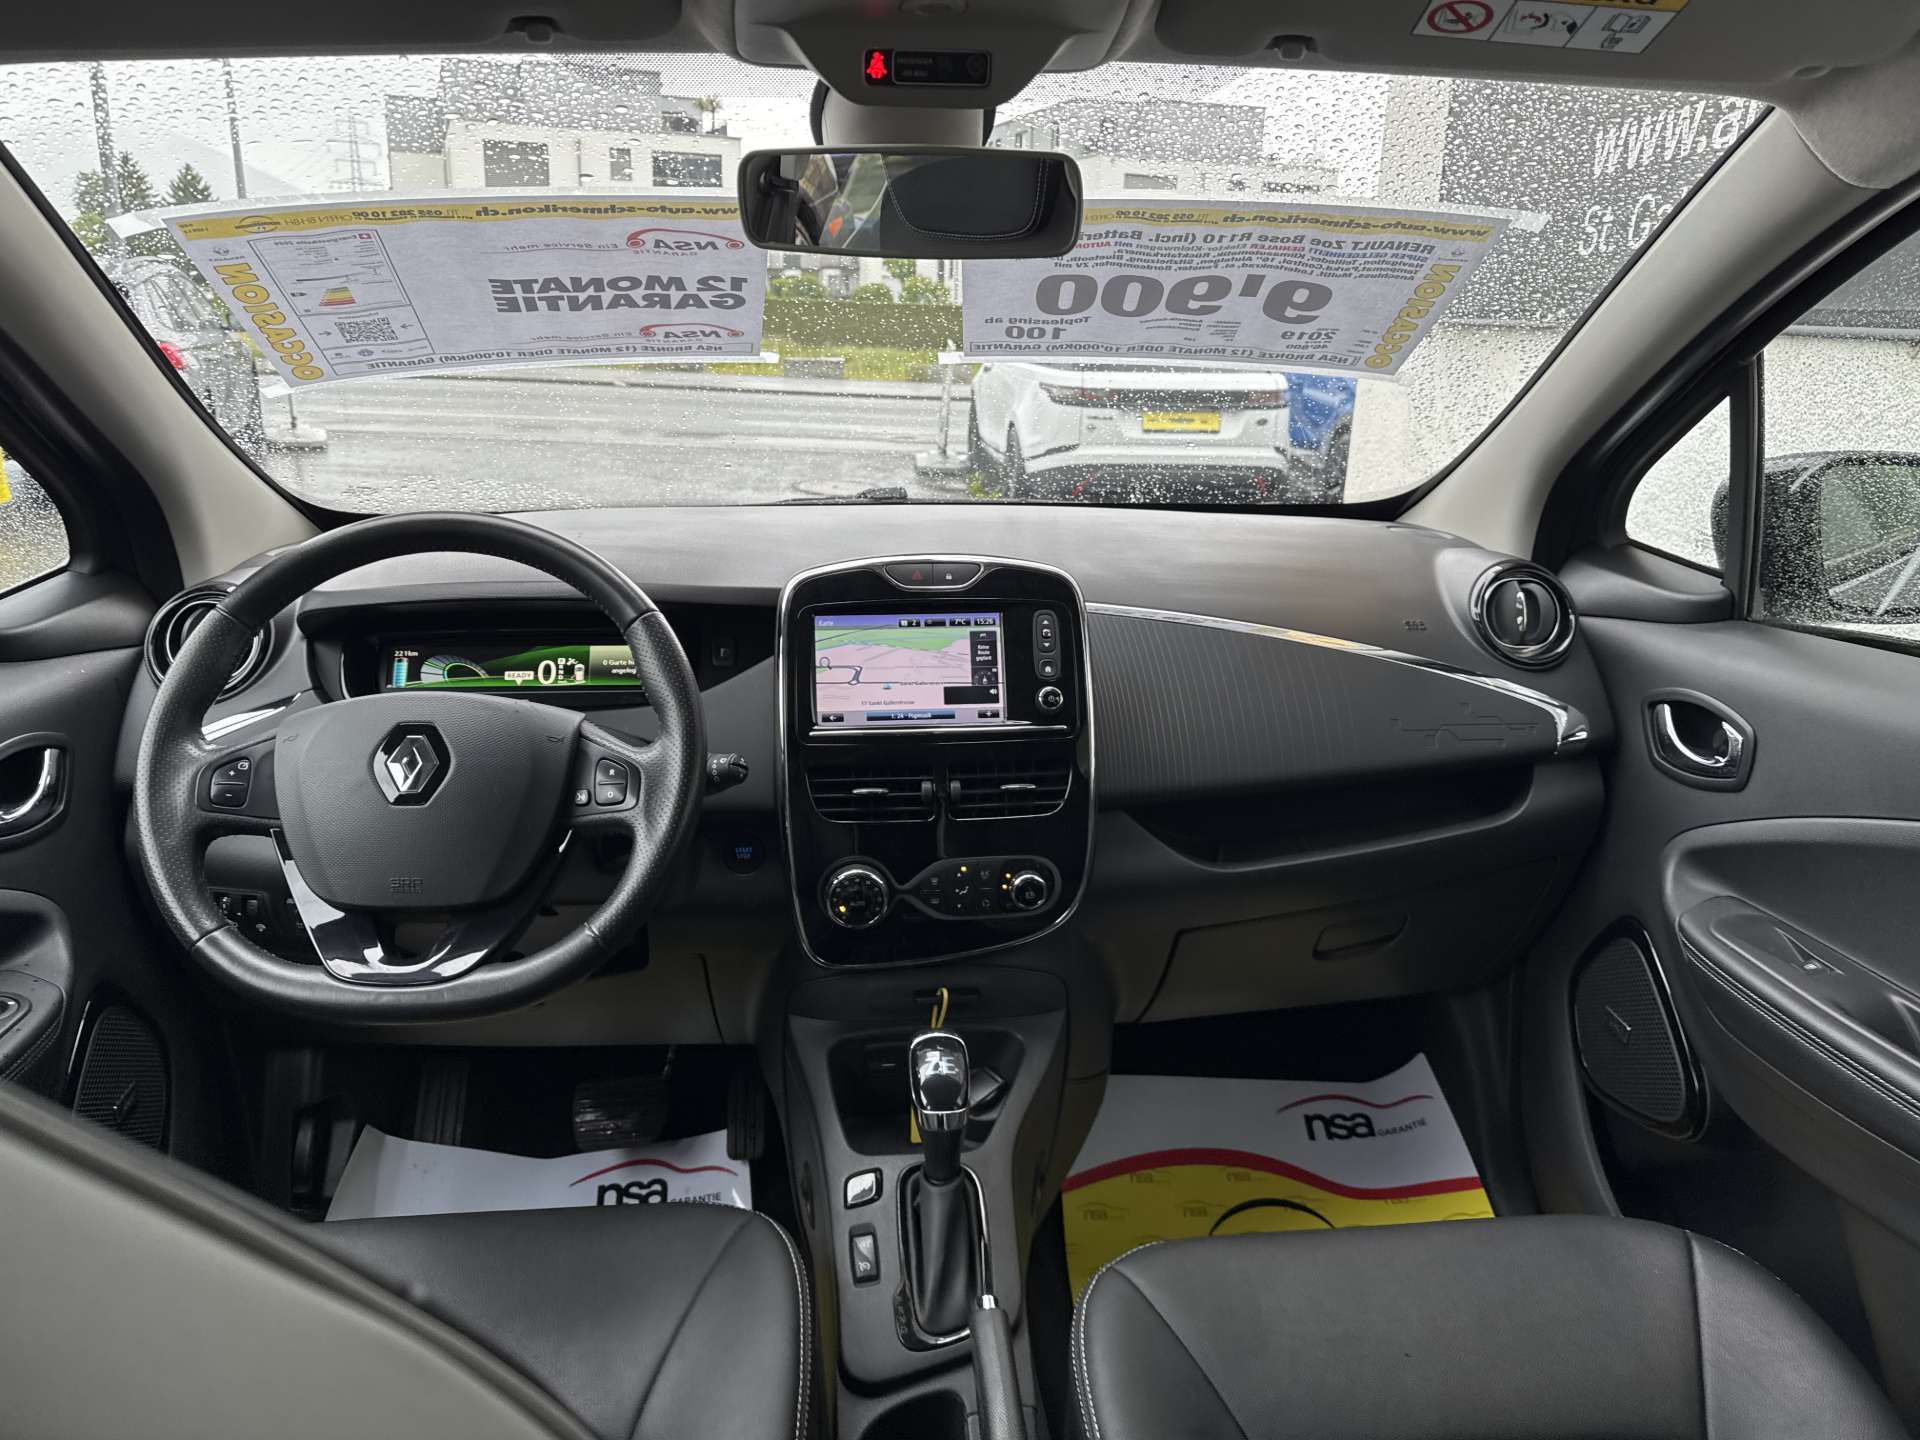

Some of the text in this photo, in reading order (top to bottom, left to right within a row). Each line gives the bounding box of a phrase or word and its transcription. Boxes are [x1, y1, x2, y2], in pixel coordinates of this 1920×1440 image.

[537, 659, 557, 685] 0
[1305, 1111, 1377, 1142] nsa
[1377, 1117, 1428, 1138] GARANTIE
[597, 1178, 669, 1206] nsa
